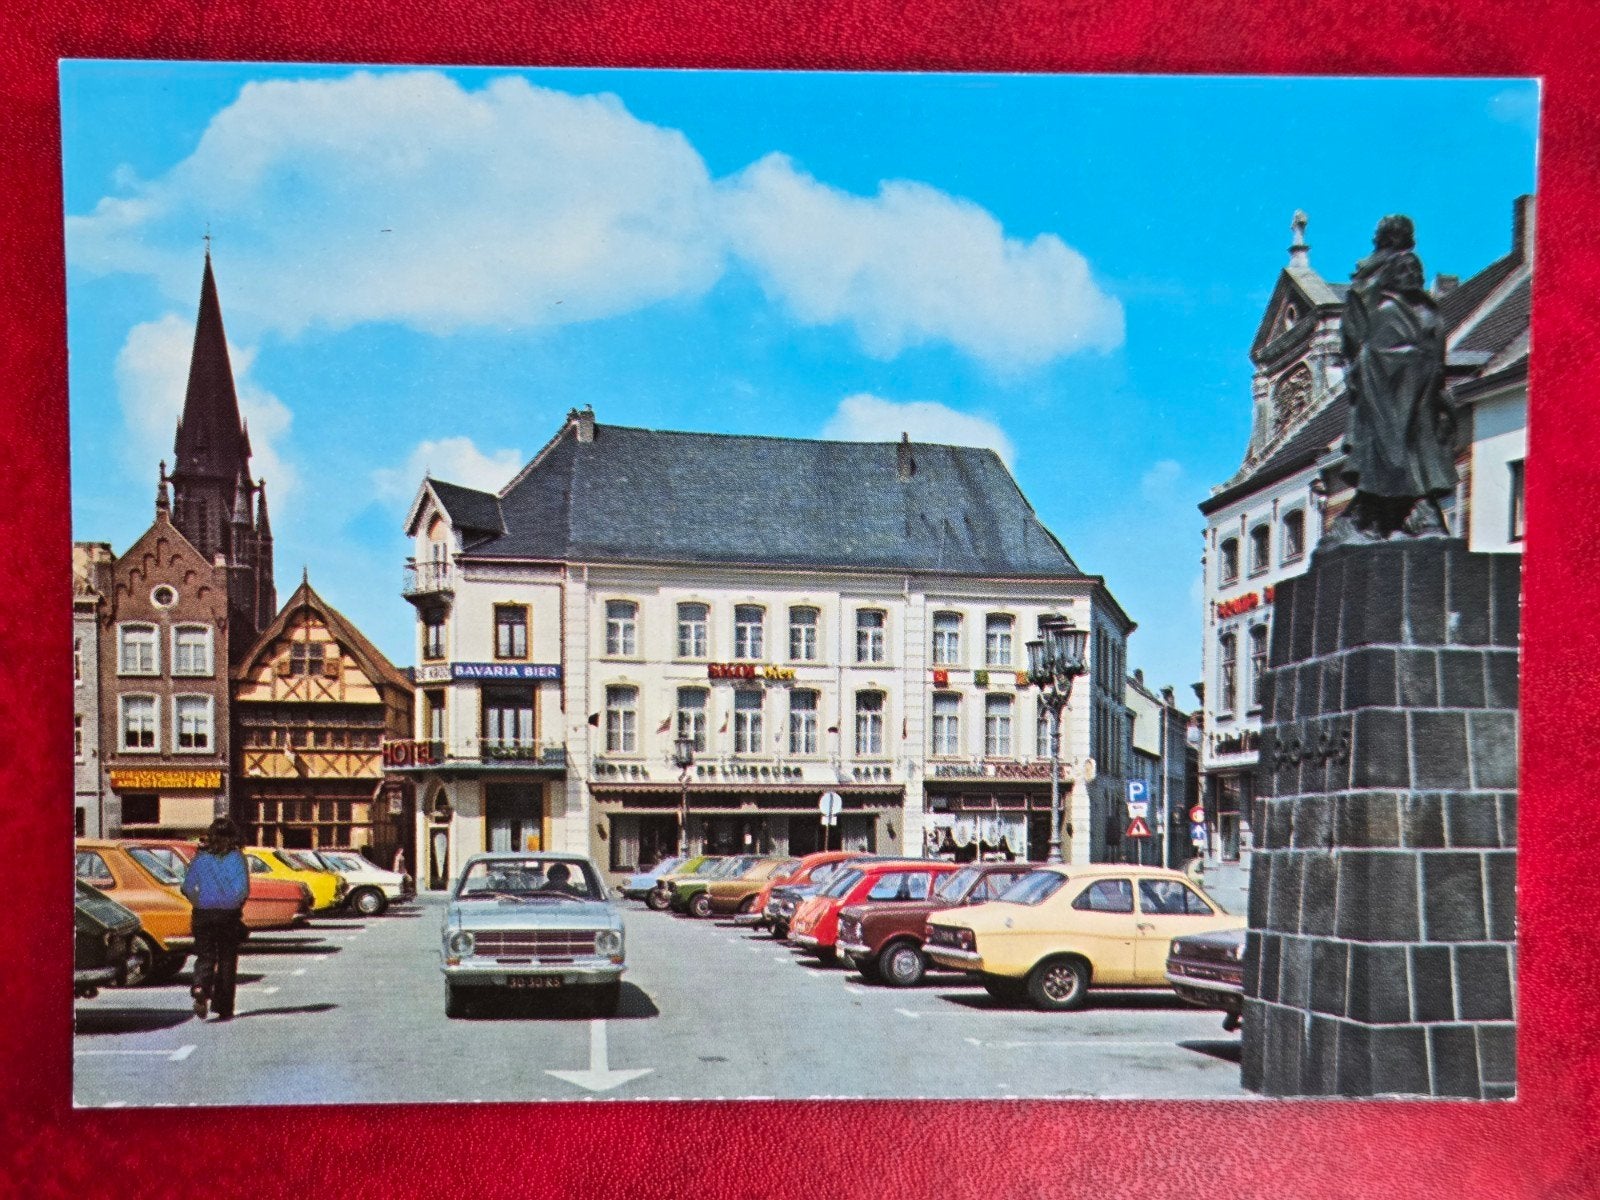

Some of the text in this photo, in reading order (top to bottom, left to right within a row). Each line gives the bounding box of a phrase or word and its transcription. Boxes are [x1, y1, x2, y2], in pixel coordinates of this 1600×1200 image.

[454, 665, 520, 678] BAVARIA
[523, 667, 557, 678] BIER
[383, 742, 435, 766] HOTEL
[595, 764, 649, 780] HOTEL
[697, 764, 716, 777] DE
[1129, 781, 1144, 801] P
